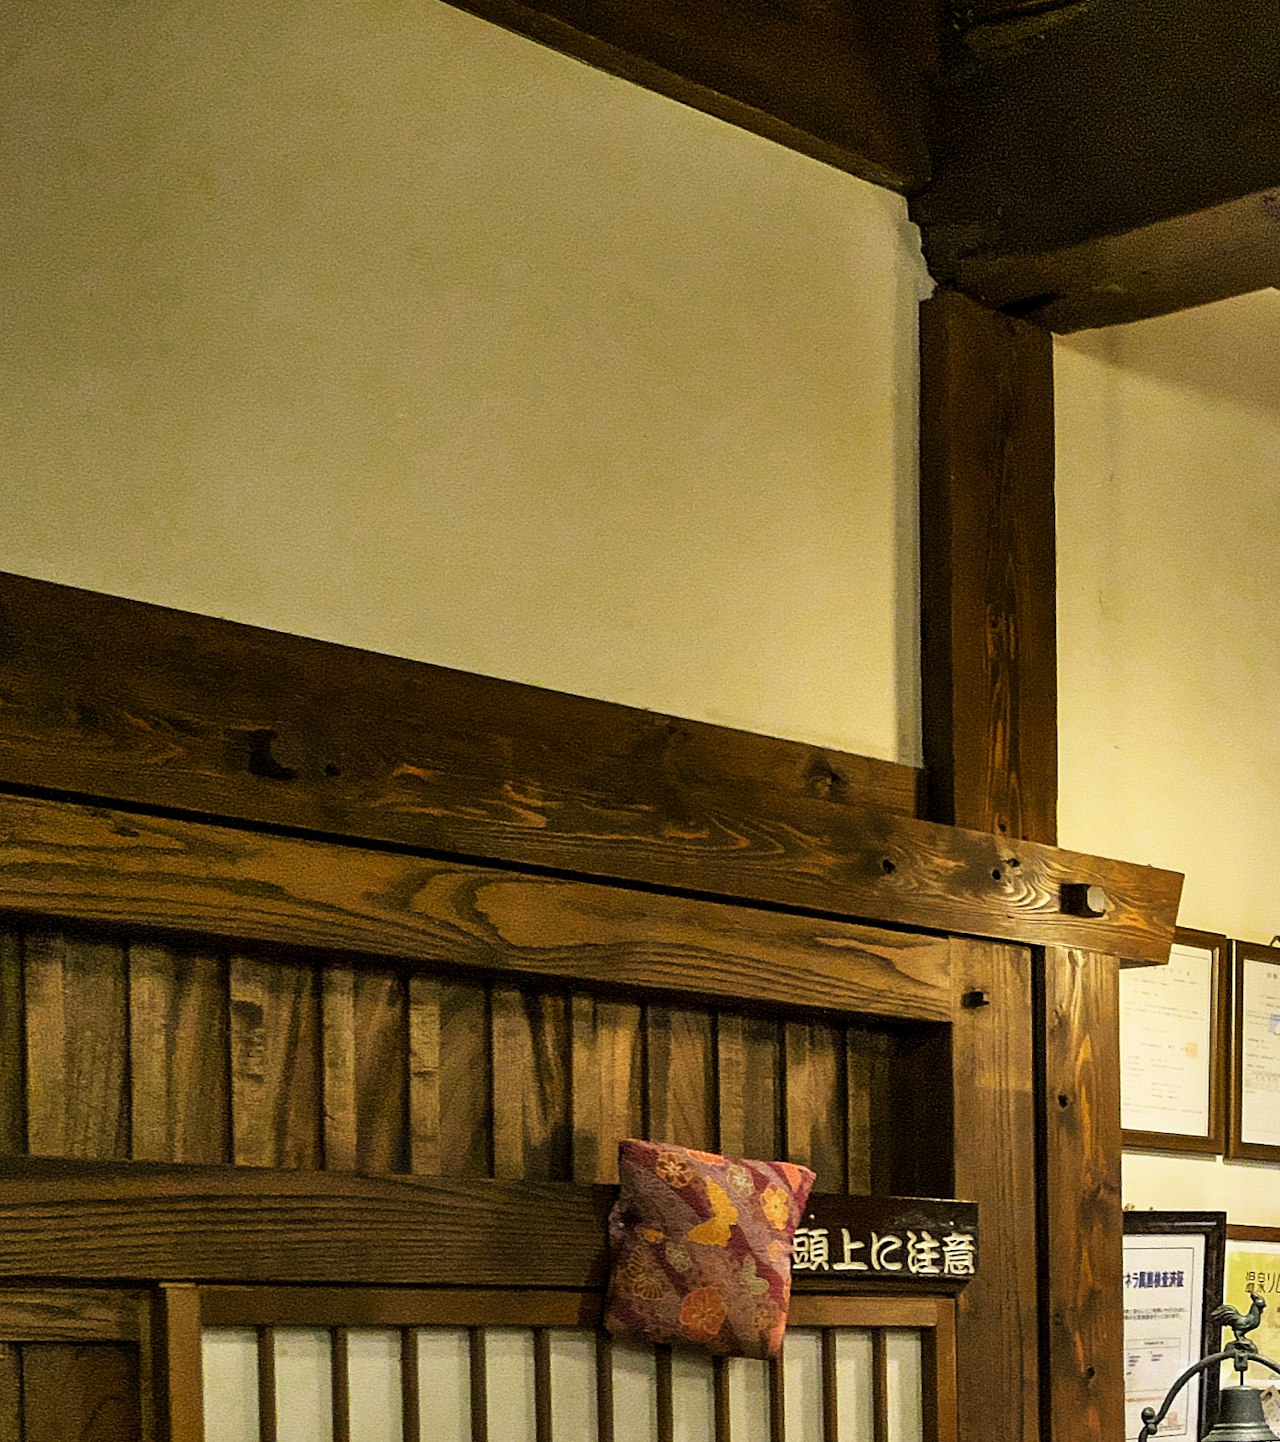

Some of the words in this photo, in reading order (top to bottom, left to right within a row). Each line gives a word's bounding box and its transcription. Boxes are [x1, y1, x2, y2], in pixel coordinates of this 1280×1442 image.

[791, 1227, 976, 1278] 頭上に注意
